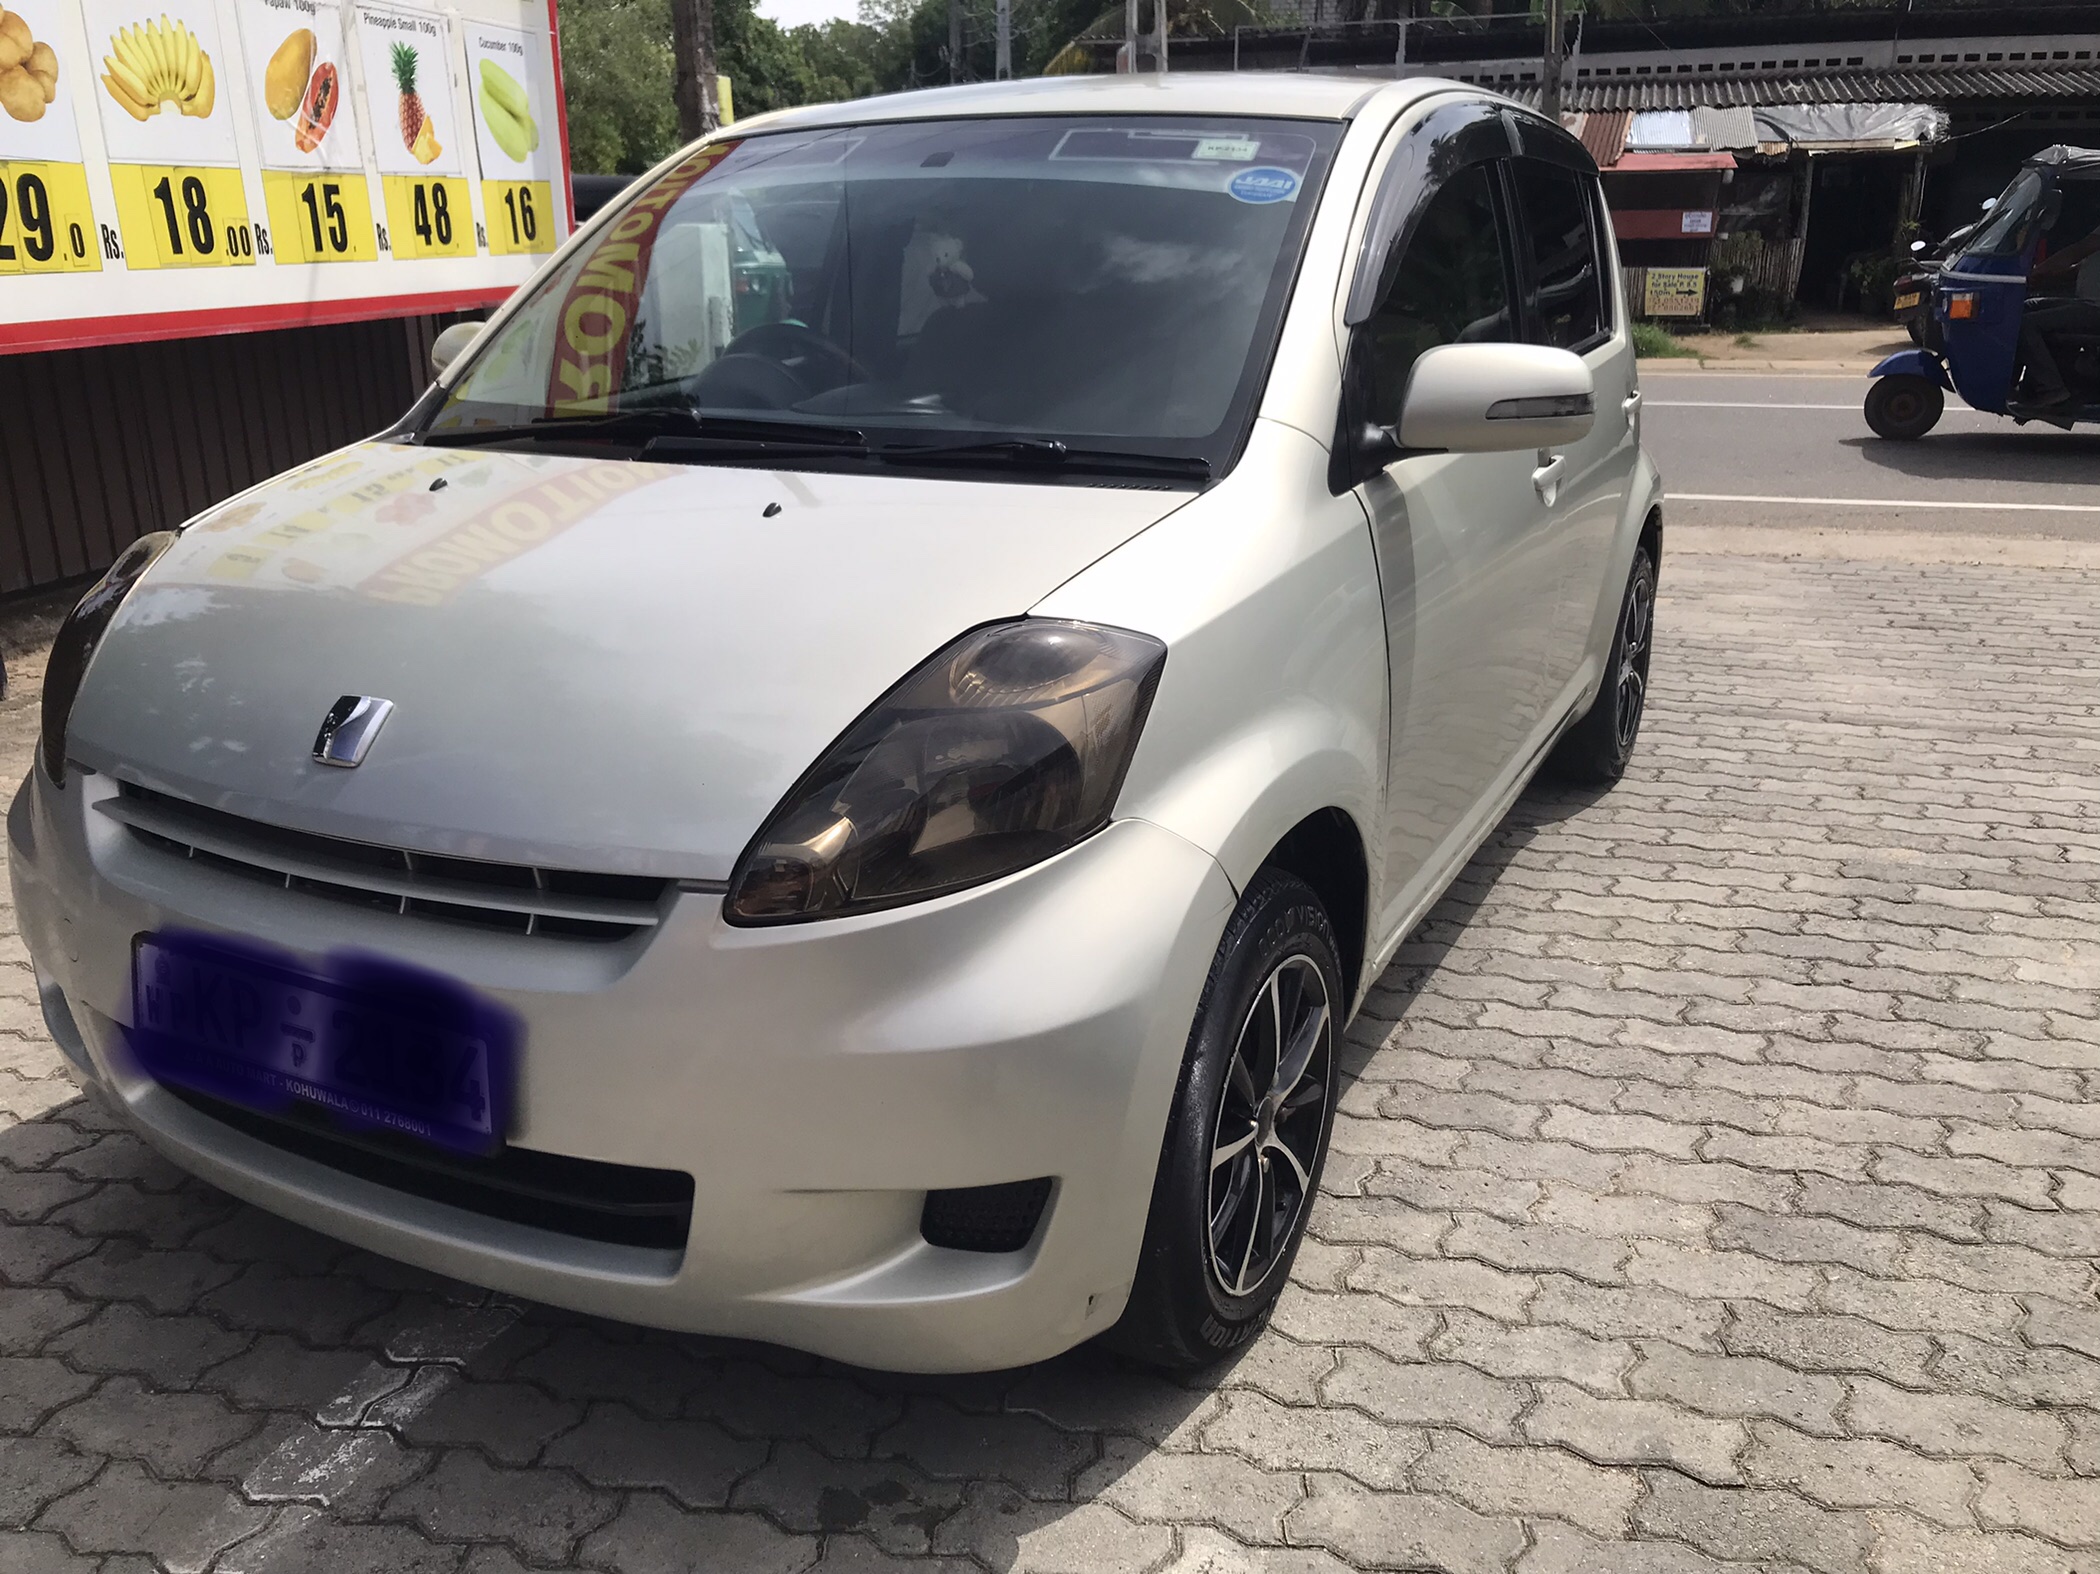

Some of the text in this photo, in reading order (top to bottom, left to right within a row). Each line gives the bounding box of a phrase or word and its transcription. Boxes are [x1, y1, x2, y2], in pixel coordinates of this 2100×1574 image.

[294, 0, 316, 16] 100g
[363, 12, 437, 37] Pineapple Small 100g
[101, 223, 125, 259] Rs.
[254, 223, 273, 255] Rs.
[376, 223, 392, 251] Rs.
[476, 222, 489, 248] Rs.
[285, 1078, 349, 1111] KOHUWALA
[360, 1103, 381, 1121] 011
[383, 1110, 432, 1137] 2768001
